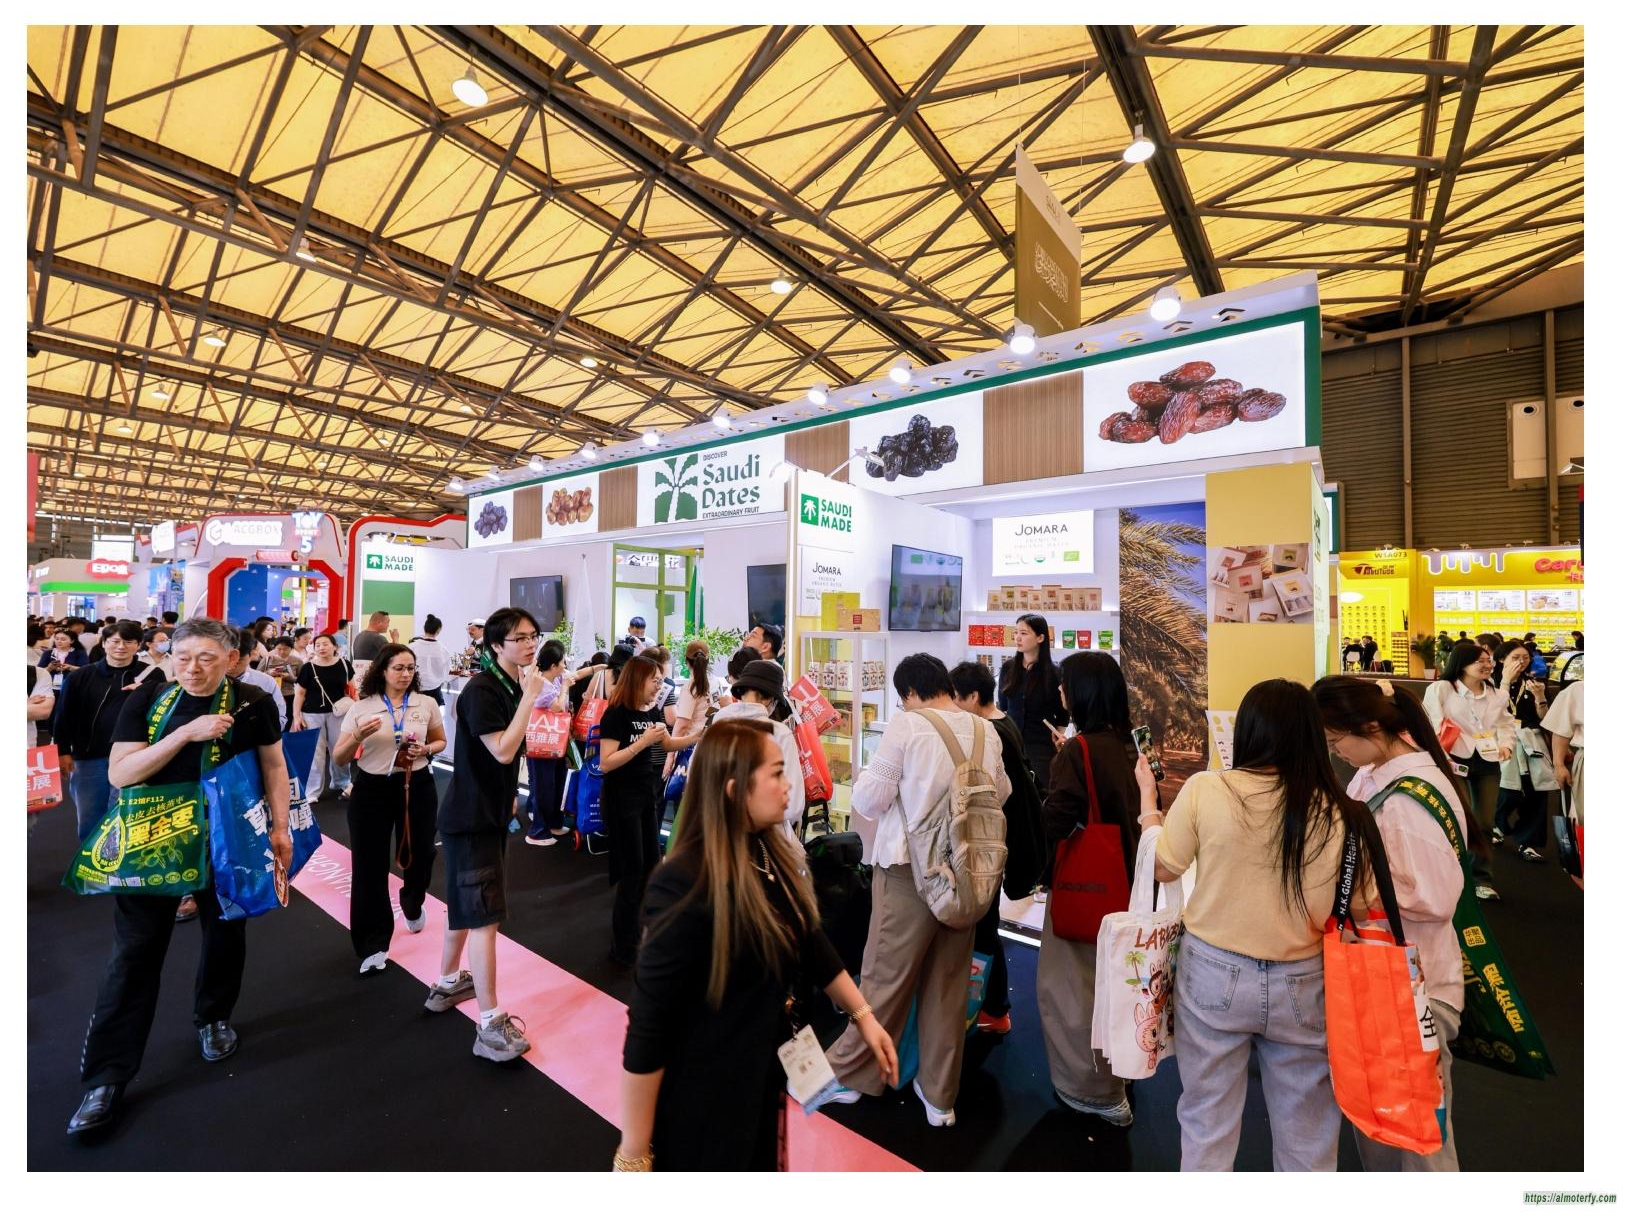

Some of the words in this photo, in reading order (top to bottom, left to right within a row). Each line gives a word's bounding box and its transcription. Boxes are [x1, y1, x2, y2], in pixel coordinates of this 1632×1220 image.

[703, 450, 728, 462] DISCOVER
[702, 453, 761, 486] Saudi
[701, 485, 761, 510] Dates
[702, 508, 744, 519] EXTRAORDINARY
[744, 506, 760, 515] FRUIT
[821, 499, 852, 517] SAUDI
[292, 512, 323, 529] TOY
[821, 514, 852, 533] MADE
[1015, 523, 1069, 536] JOMARA
[300, 536, 312, 553] 5
[385, 555, 414, 564] SAUDI
[385, 563, 414, 572] MADE
[813, 562, 841, 576] JOMARA
